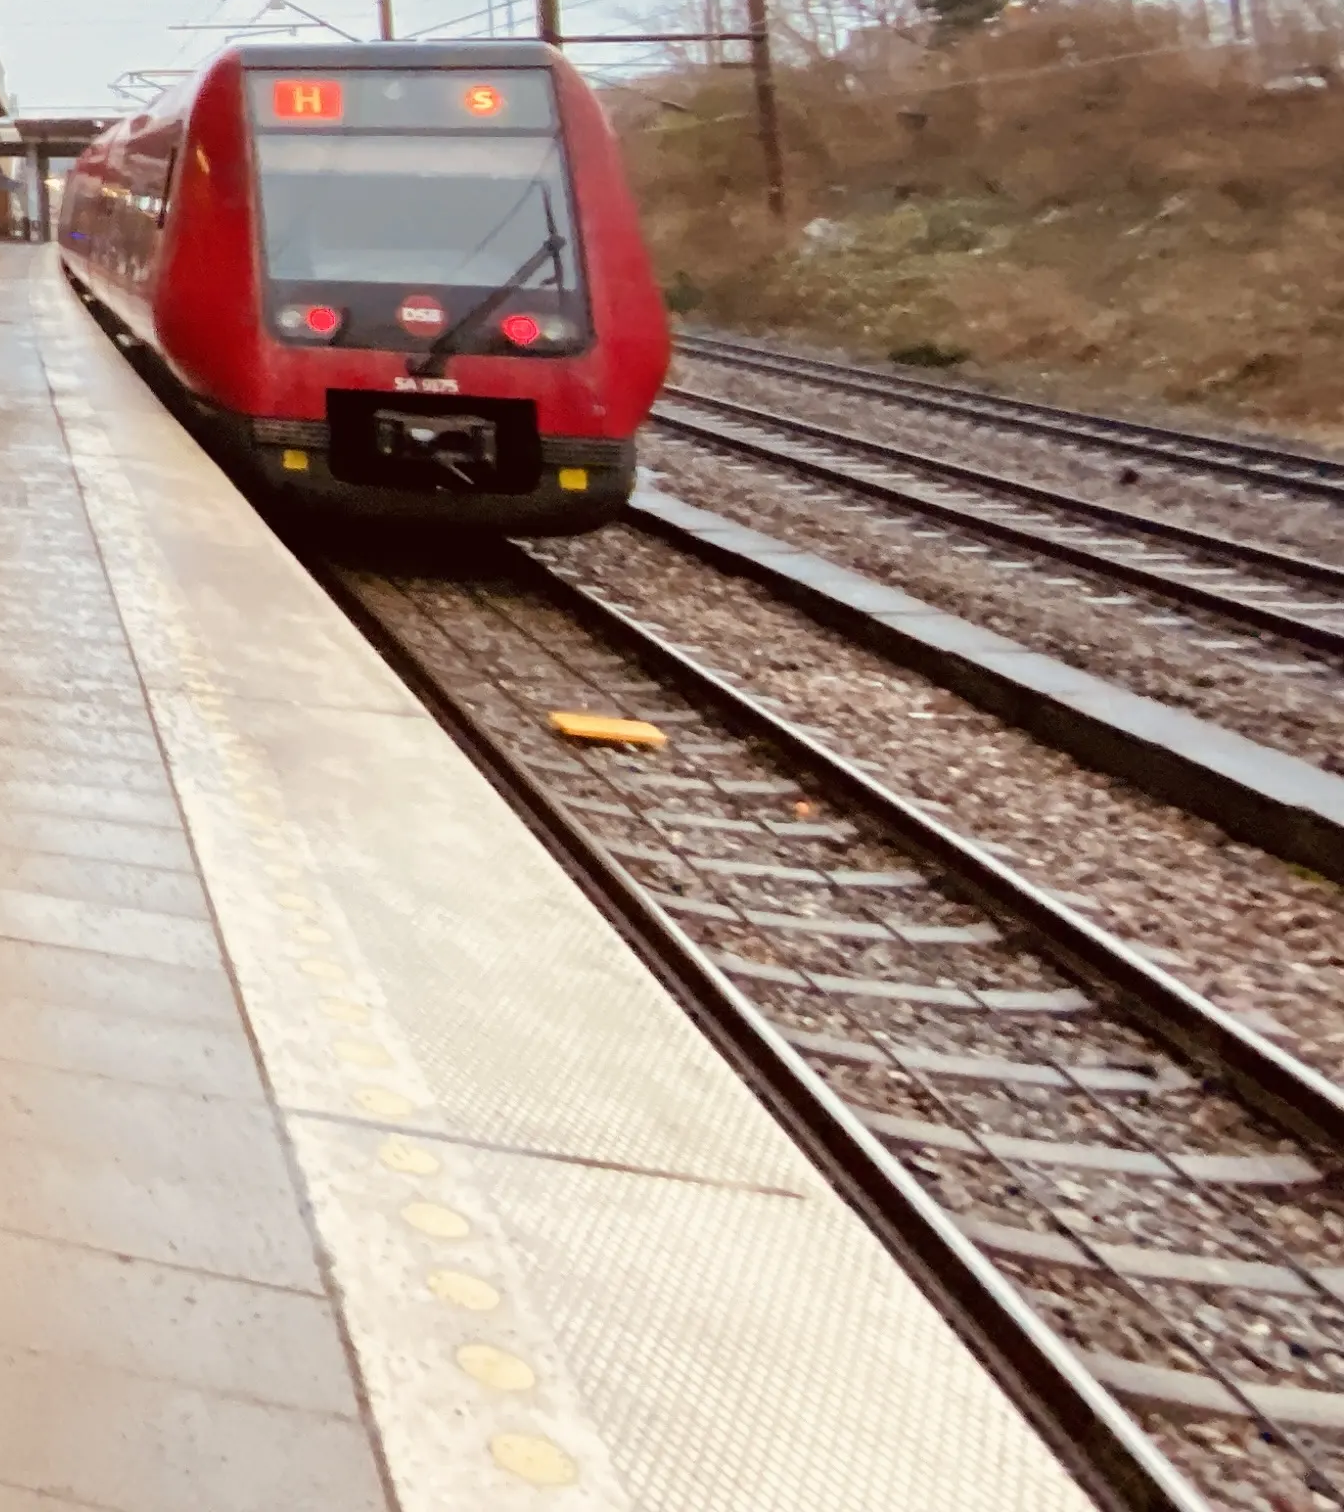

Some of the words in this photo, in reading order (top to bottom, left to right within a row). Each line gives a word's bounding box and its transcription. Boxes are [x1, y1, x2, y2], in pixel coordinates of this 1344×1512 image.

[294, 87, 321, 113] H
[473, 91, 494, 109] S
[402, 307, 442, 322] DSB
[394, 376, 417, 391] SA
